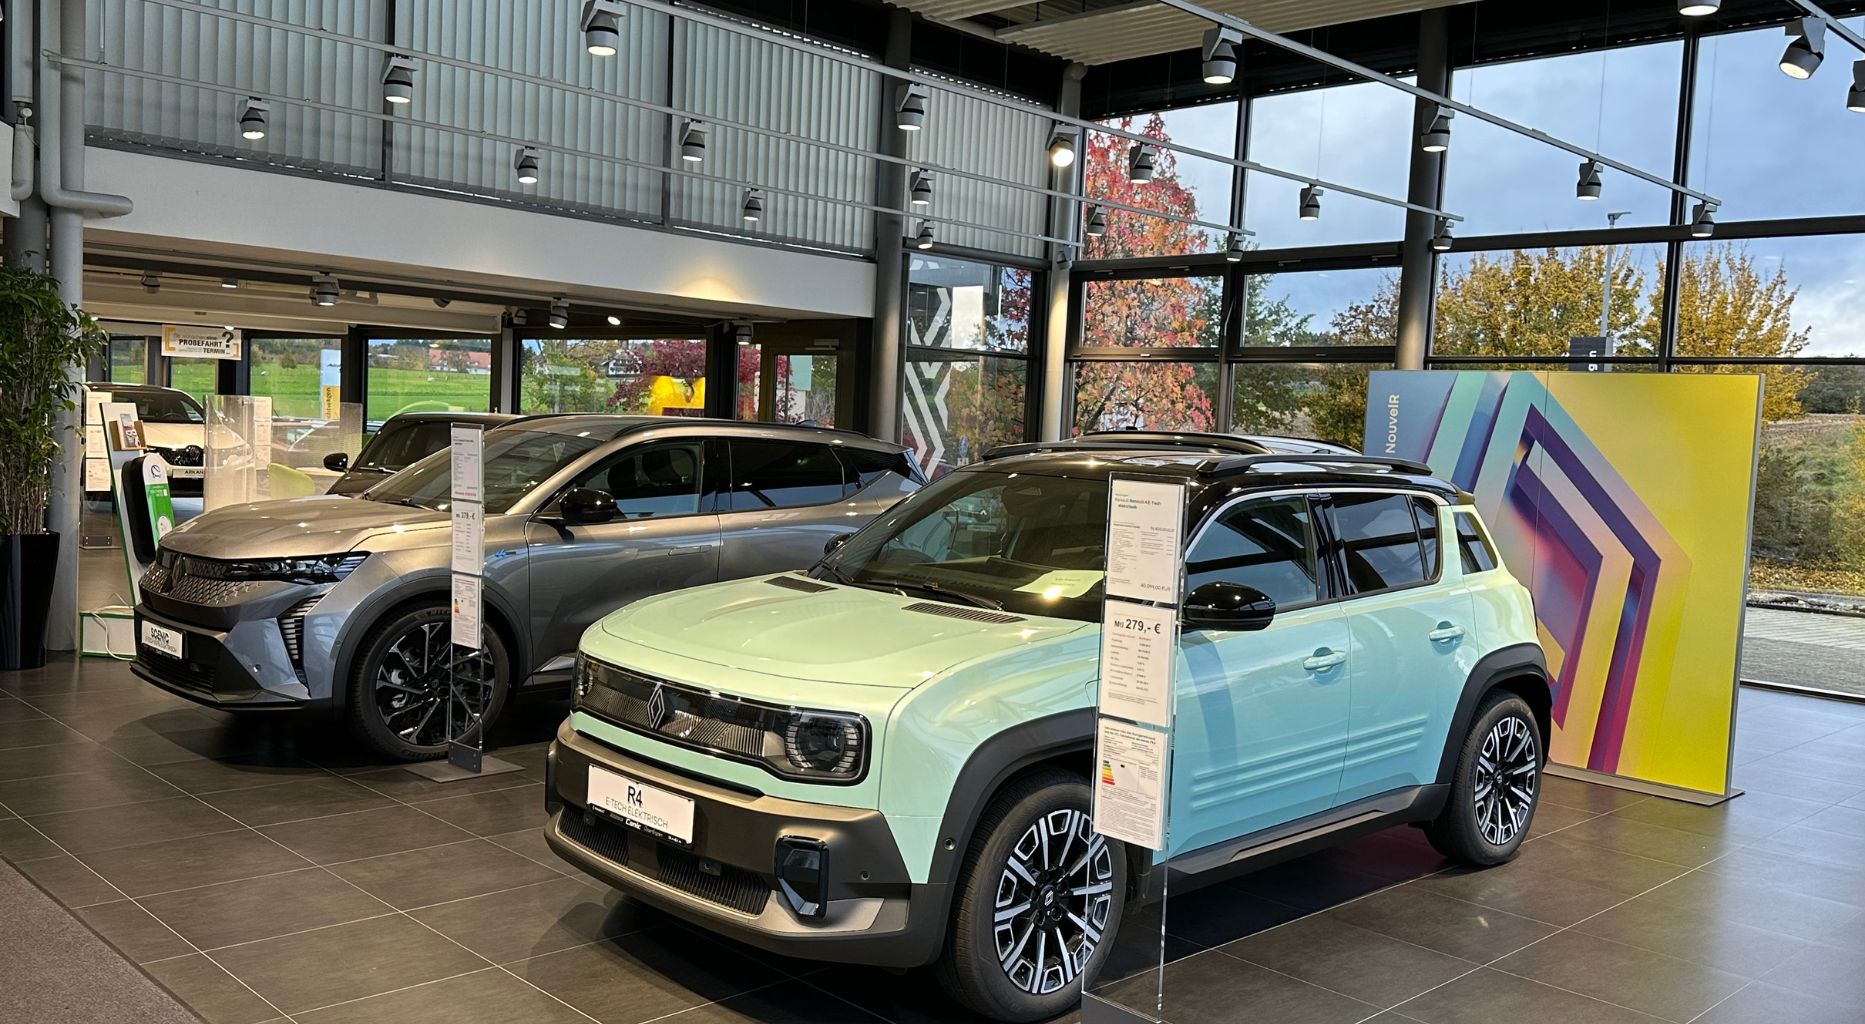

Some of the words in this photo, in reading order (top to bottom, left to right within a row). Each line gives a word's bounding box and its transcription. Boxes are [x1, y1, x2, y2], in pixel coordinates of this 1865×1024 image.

[178, 338, 223, 348] PROBEFAHRT
[1385, 394, 1400, 454] NouvelR
[1154, 623, 1161, 634] €
[627, 785, 643, 808] R4
[605, 796, 627, 812] E-TECH
[627, 807, 669, 829] ELEKTRISCH
